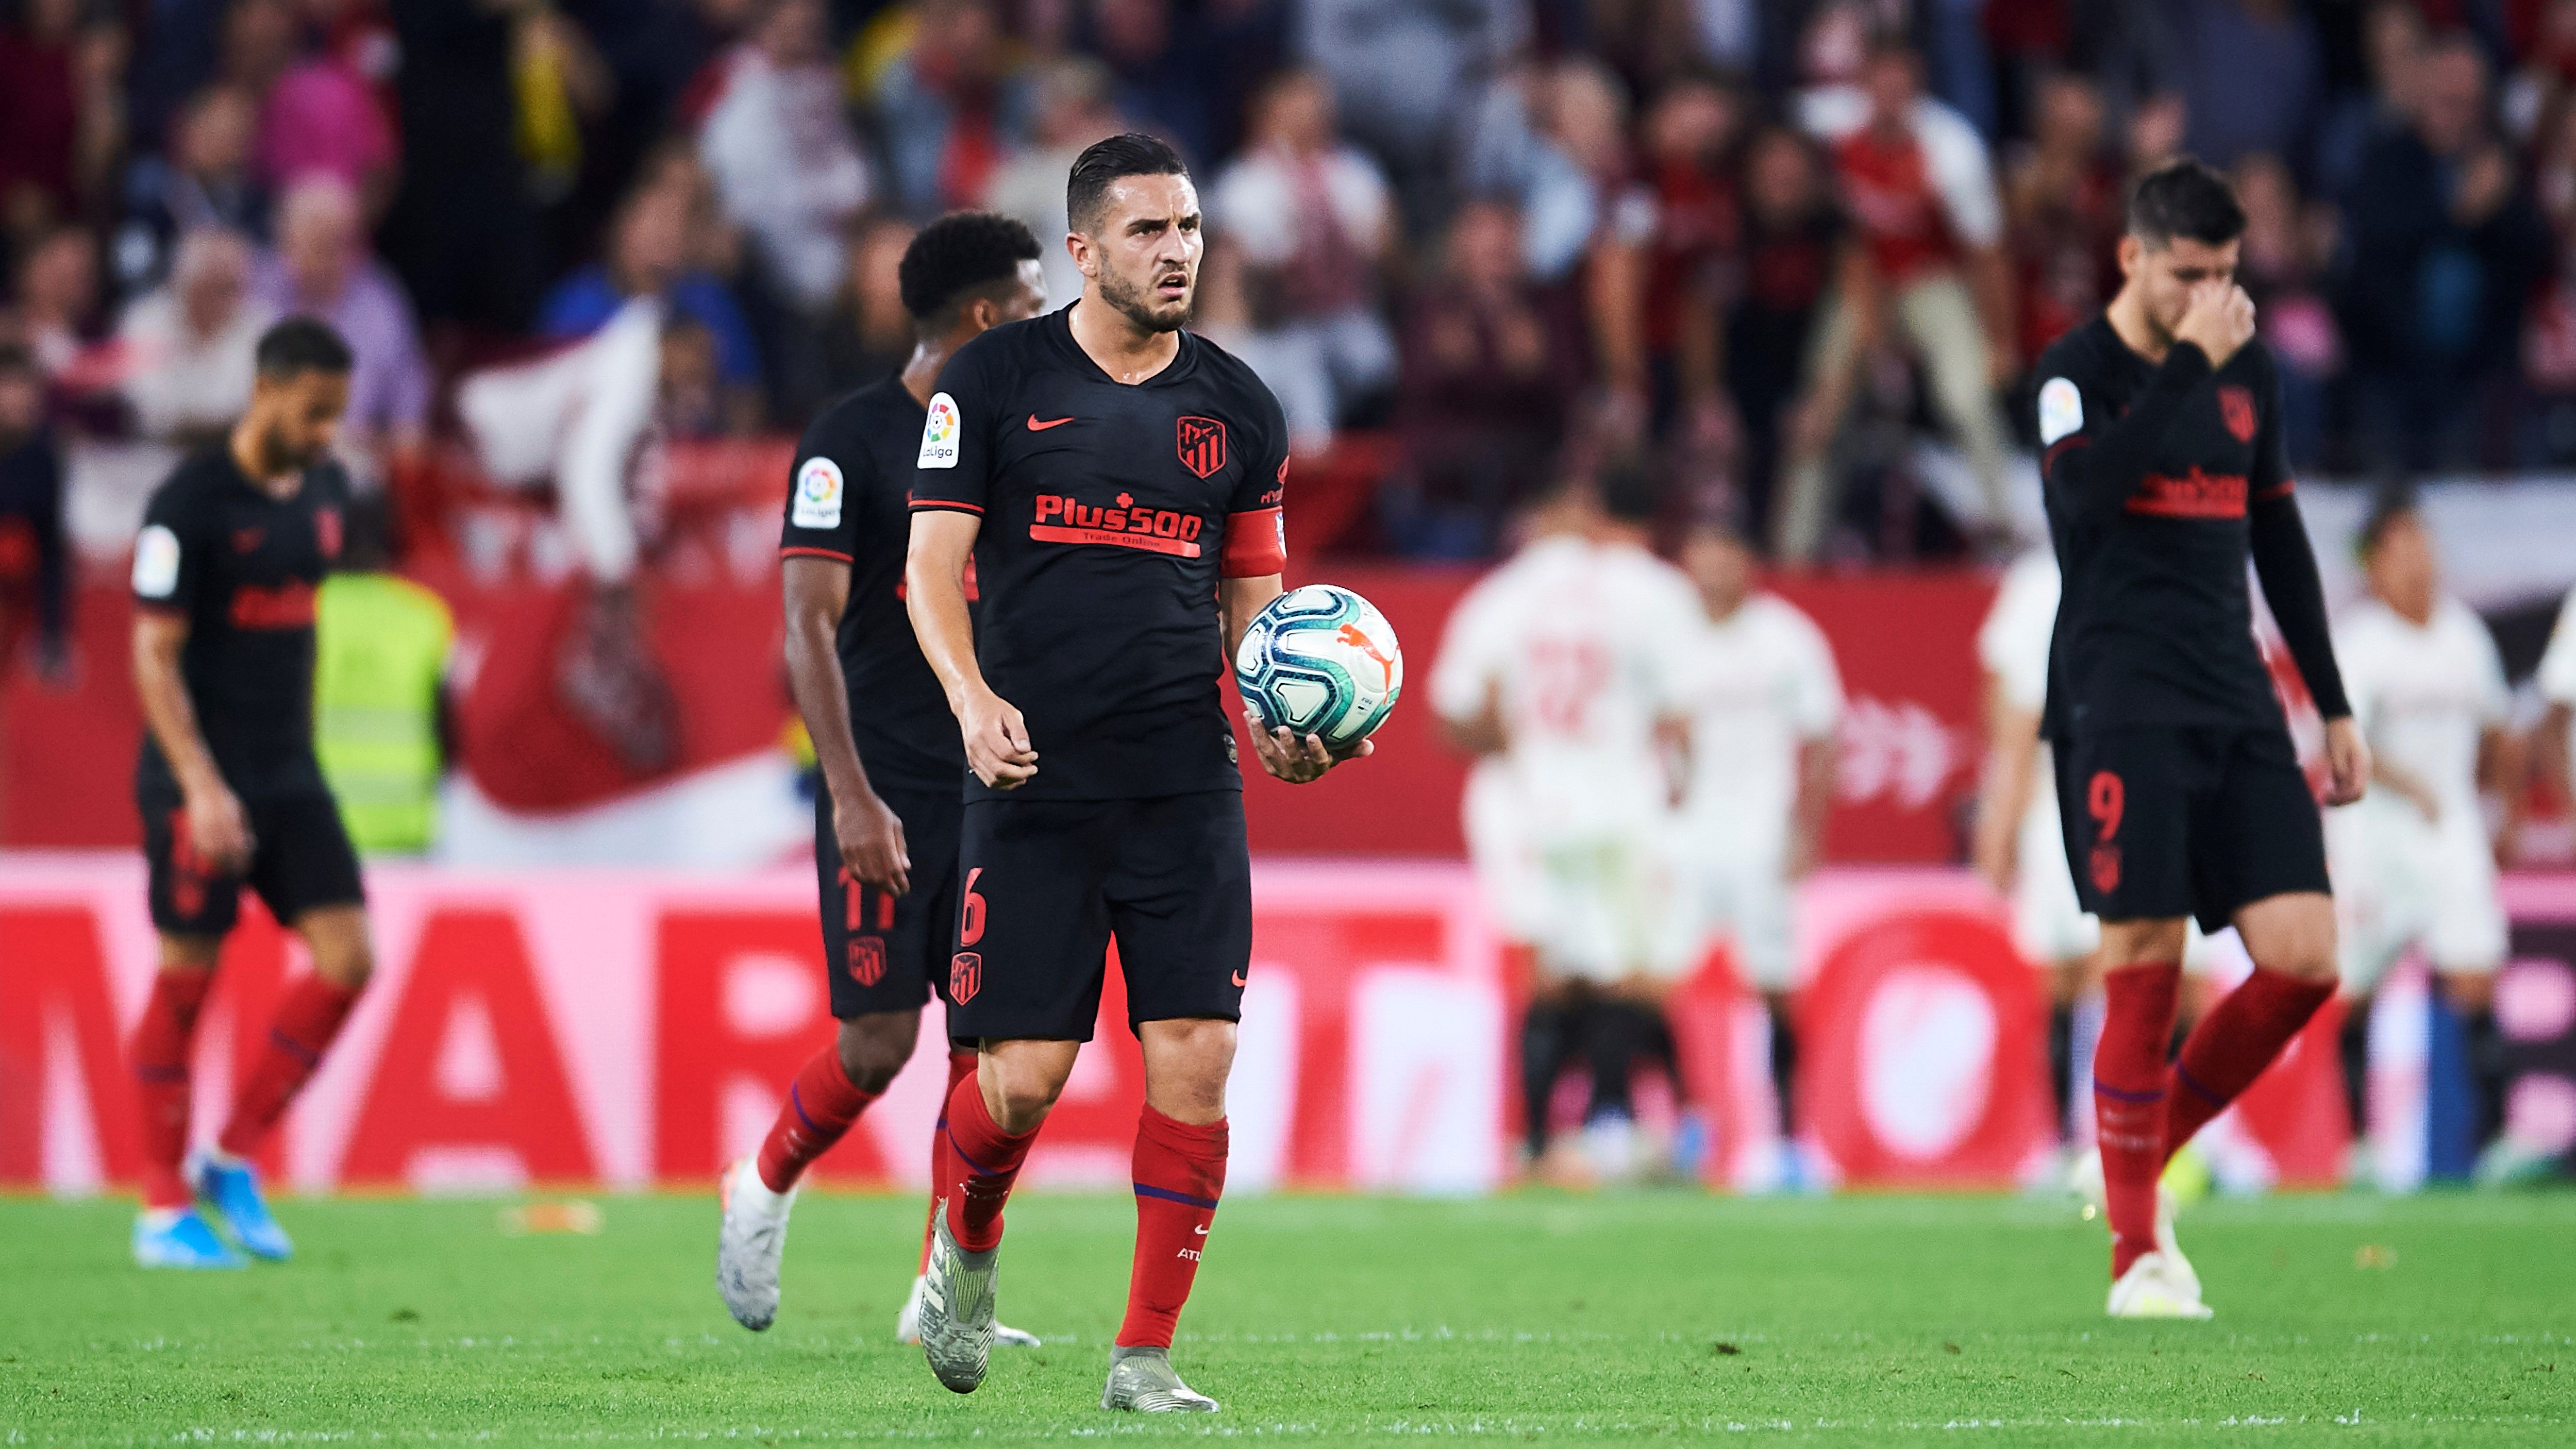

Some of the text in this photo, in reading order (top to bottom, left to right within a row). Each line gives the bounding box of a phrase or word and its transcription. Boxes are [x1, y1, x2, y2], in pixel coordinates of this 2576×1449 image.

[923, 446, 952, 458] LaLiga
[1035, 492, 1202, 541] Plus500
[1083, 532, 1160, 548] Trade Online
[2087, 769, 2125, 841] 9
[961, 867, 986, 947] 6
